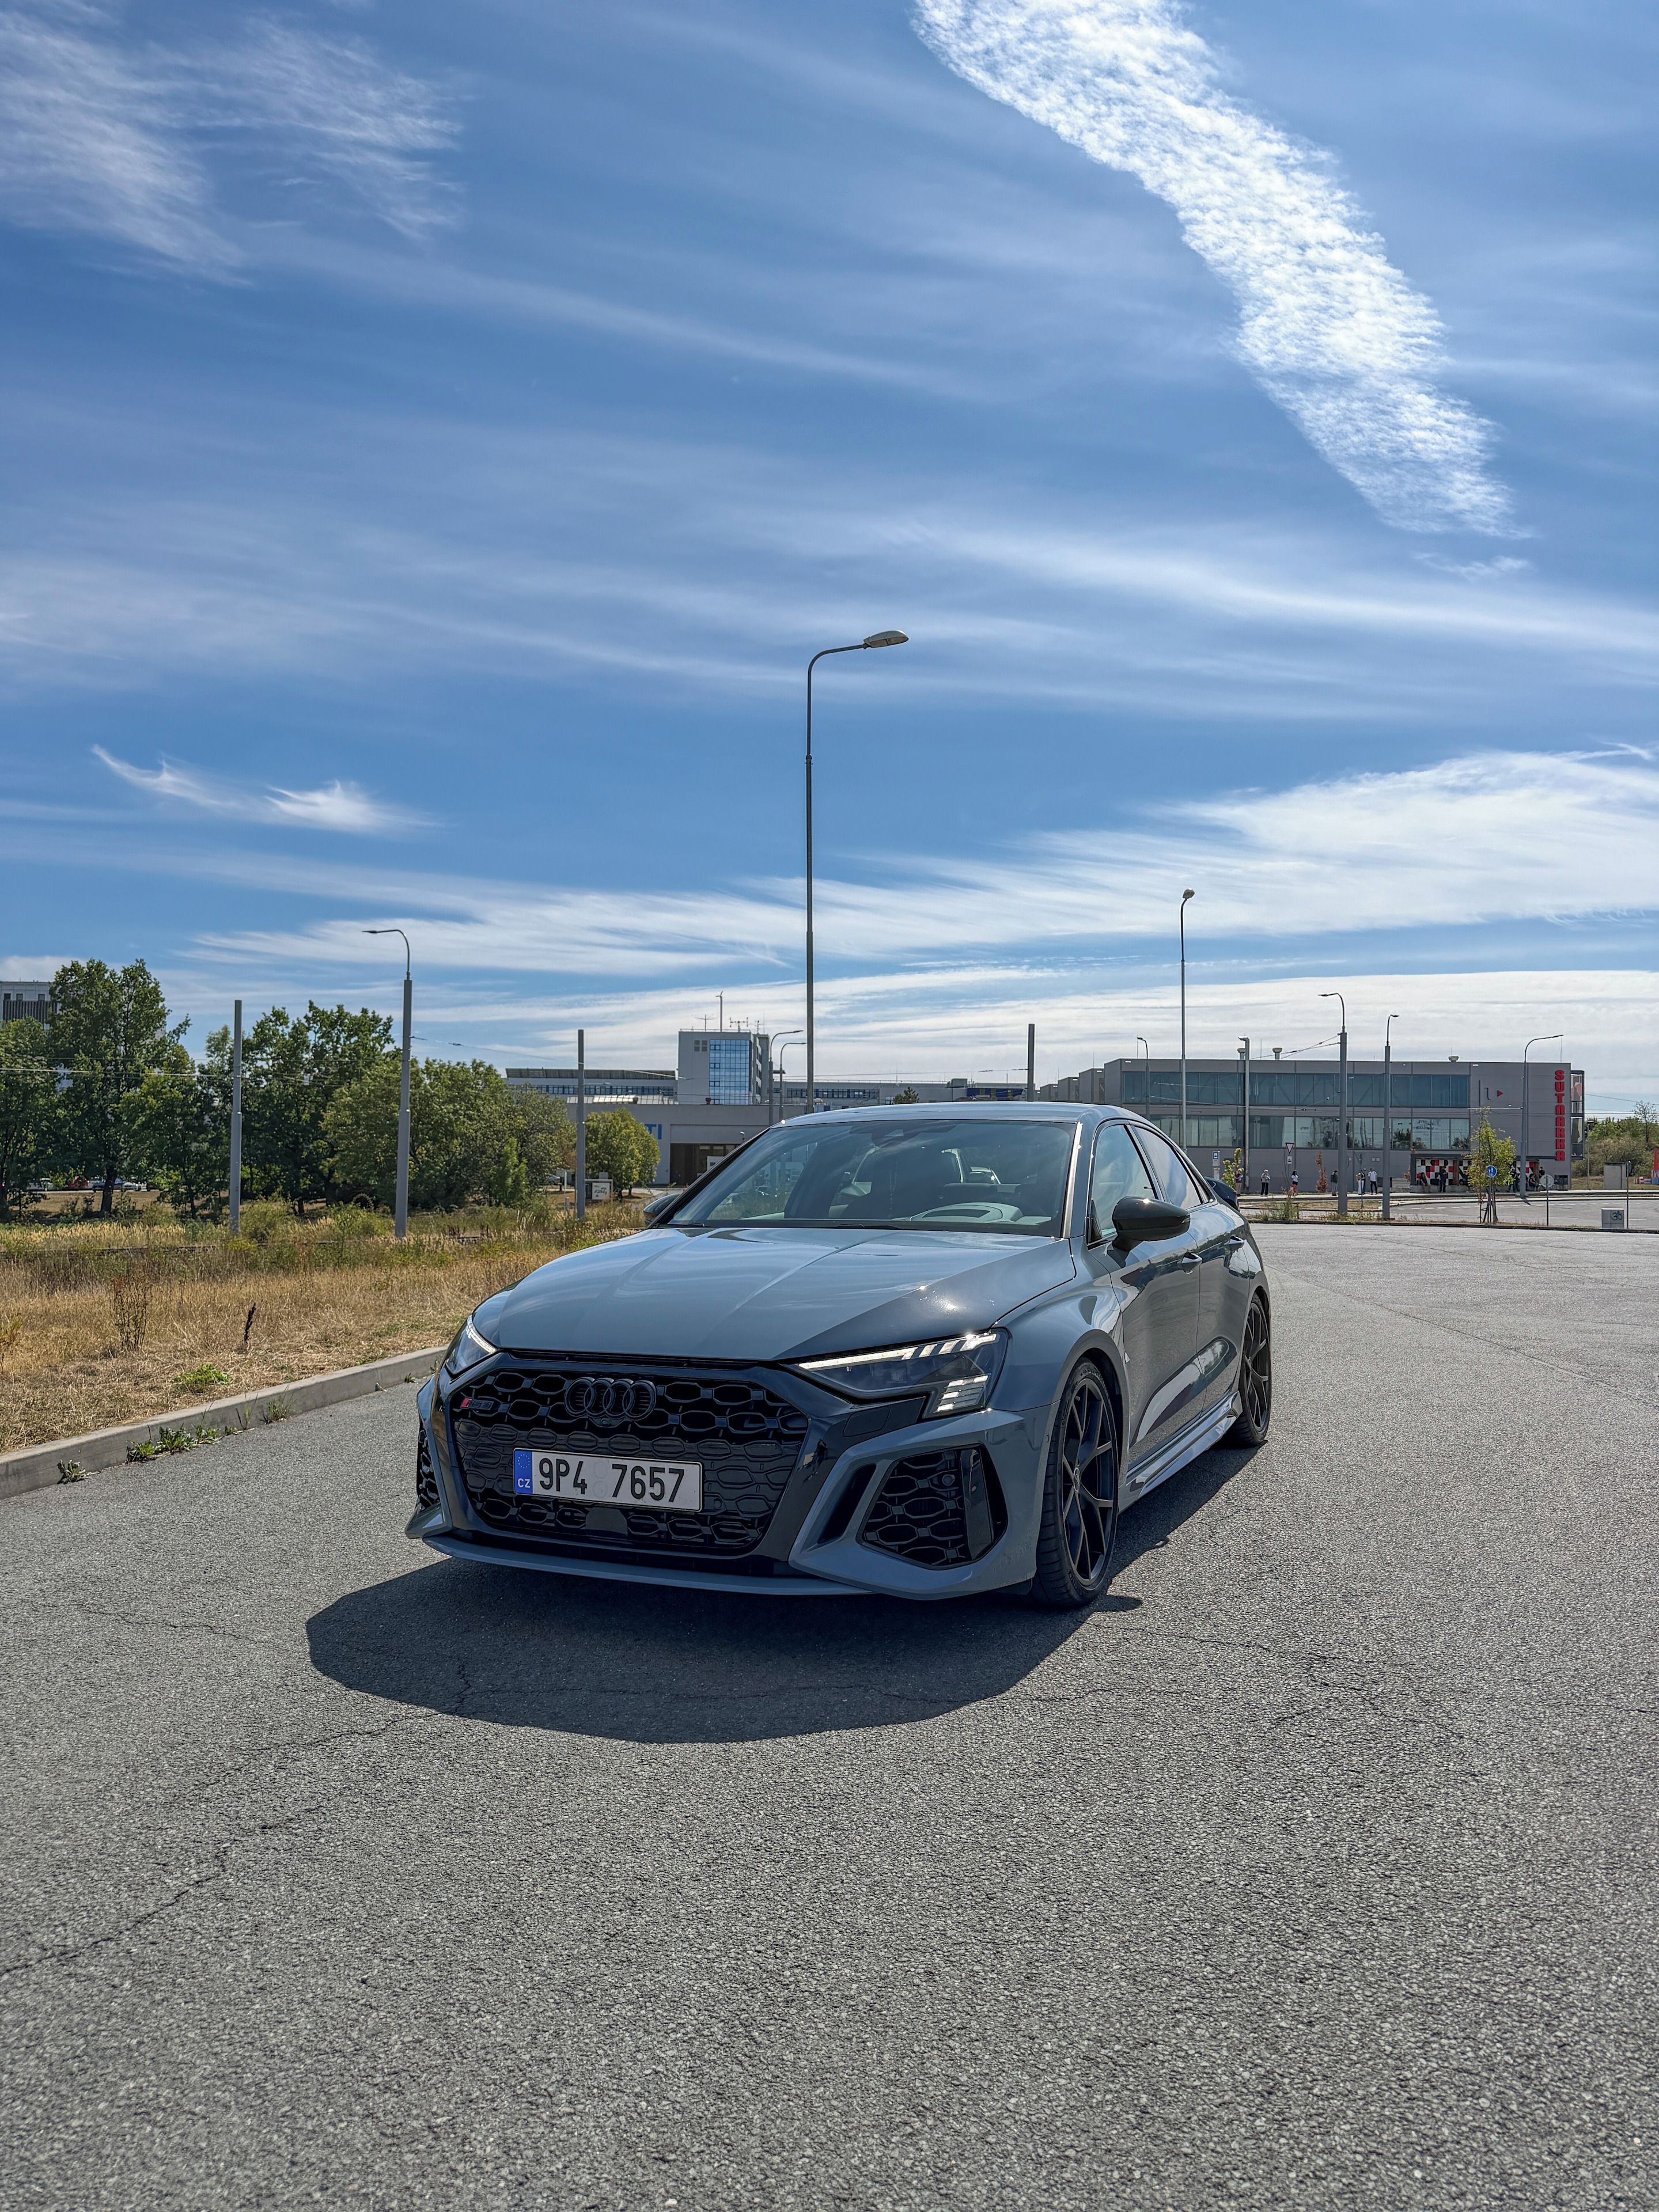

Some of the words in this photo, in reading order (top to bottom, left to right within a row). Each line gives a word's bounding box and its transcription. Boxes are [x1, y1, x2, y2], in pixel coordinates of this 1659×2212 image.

[518, 1478, 531, 1488] CZ
[539, 1458, 588, 1494] 9P4
[612, 1464, 684, 1502] 7657
